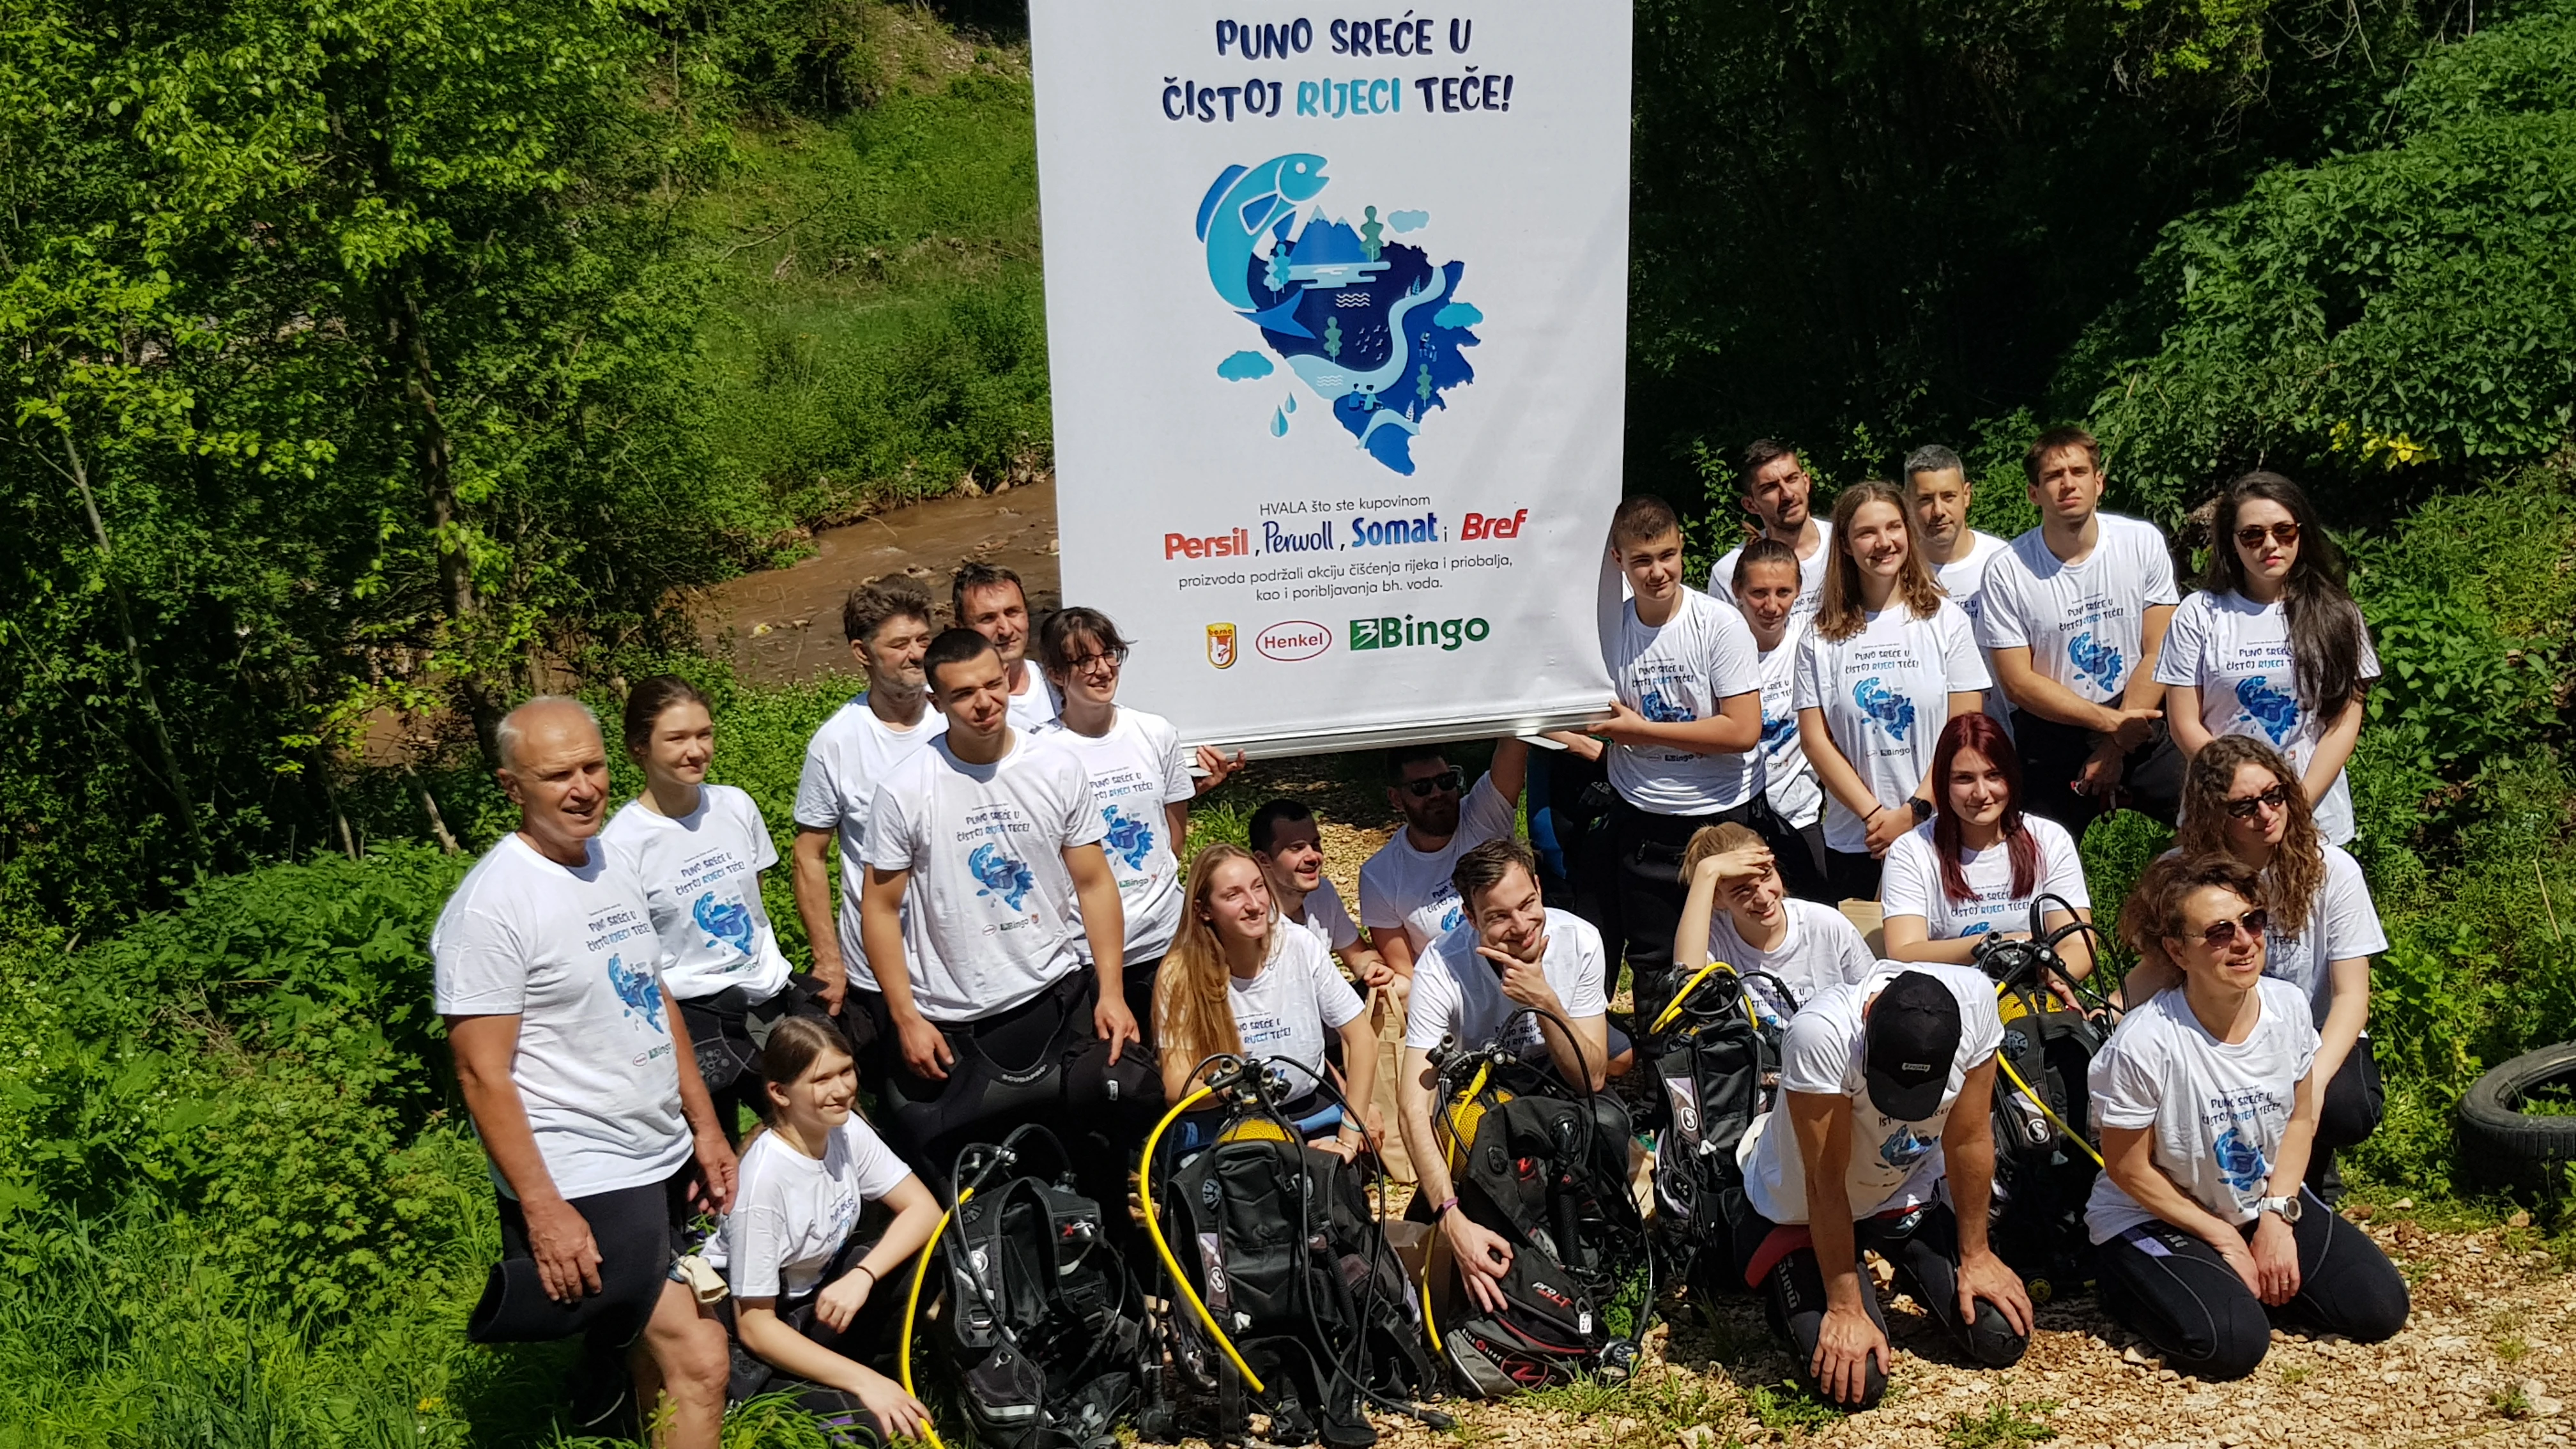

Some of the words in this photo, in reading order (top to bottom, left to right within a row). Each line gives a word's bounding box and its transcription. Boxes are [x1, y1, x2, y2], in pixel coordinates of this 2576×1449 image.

[1216, 17, 1313, 60] PUNO
[1331, 10, 1434, 57] SREĆE
[1449, 18, 1472, 54] U
[1162, 75, 1282, 123] ČISTOJ
[1296, 77, 1401, 118] RIJECI
[1415, 65, 1514, 114] TEČE!
[1260, 502, 1307, 516] HVALA
[1312, 500, 1331, 512] što
[1336, 500, 1354, 511] ste
[1360, 495, 1430, 511] kupovinom
[1352, 512, 1438, 548] Somat
[1443, 526, 1448, 542] i
[1460, 509, 1528, 541] Bref
[1179, 572, 1245, 590] proizvoda
[1250, 567, 1303, 585] podržali
[1308, 565, 1345, 579] akciju
[1349, 560, 1400, 576] čišćenja
[1405, 559, 1438, 574] rijeka
[1443, 556, 1447, 569] i
[1452, 554, 1512, 571] priobalja,
[1256, 589, 1279, 601] kao
[1284, 588, 1288, 599] i
[1293, 584, 1377, 602] poribljavanja
[1383, 580, 1402, 592] bh.
[1407, 577, 1443, 590] voda.
[1264, 632, 1323, 650] Henkel
[1381, 613, 1490, 651] Bingo
[1855, 651, 1876, 661] PUNO
[2239, 648, 2262, 657] PUNO
[1872, 661, 1894, 670] RIJECI
[2227, 661, 2255, 671] ČISTOJ
[2258, 659, 2283, 668] RIJECI
[1014, 811, 1020, 819] U
[1981, 904, 2004, 914] RIJECI
[2266, 1091, 2273, 1101] U
